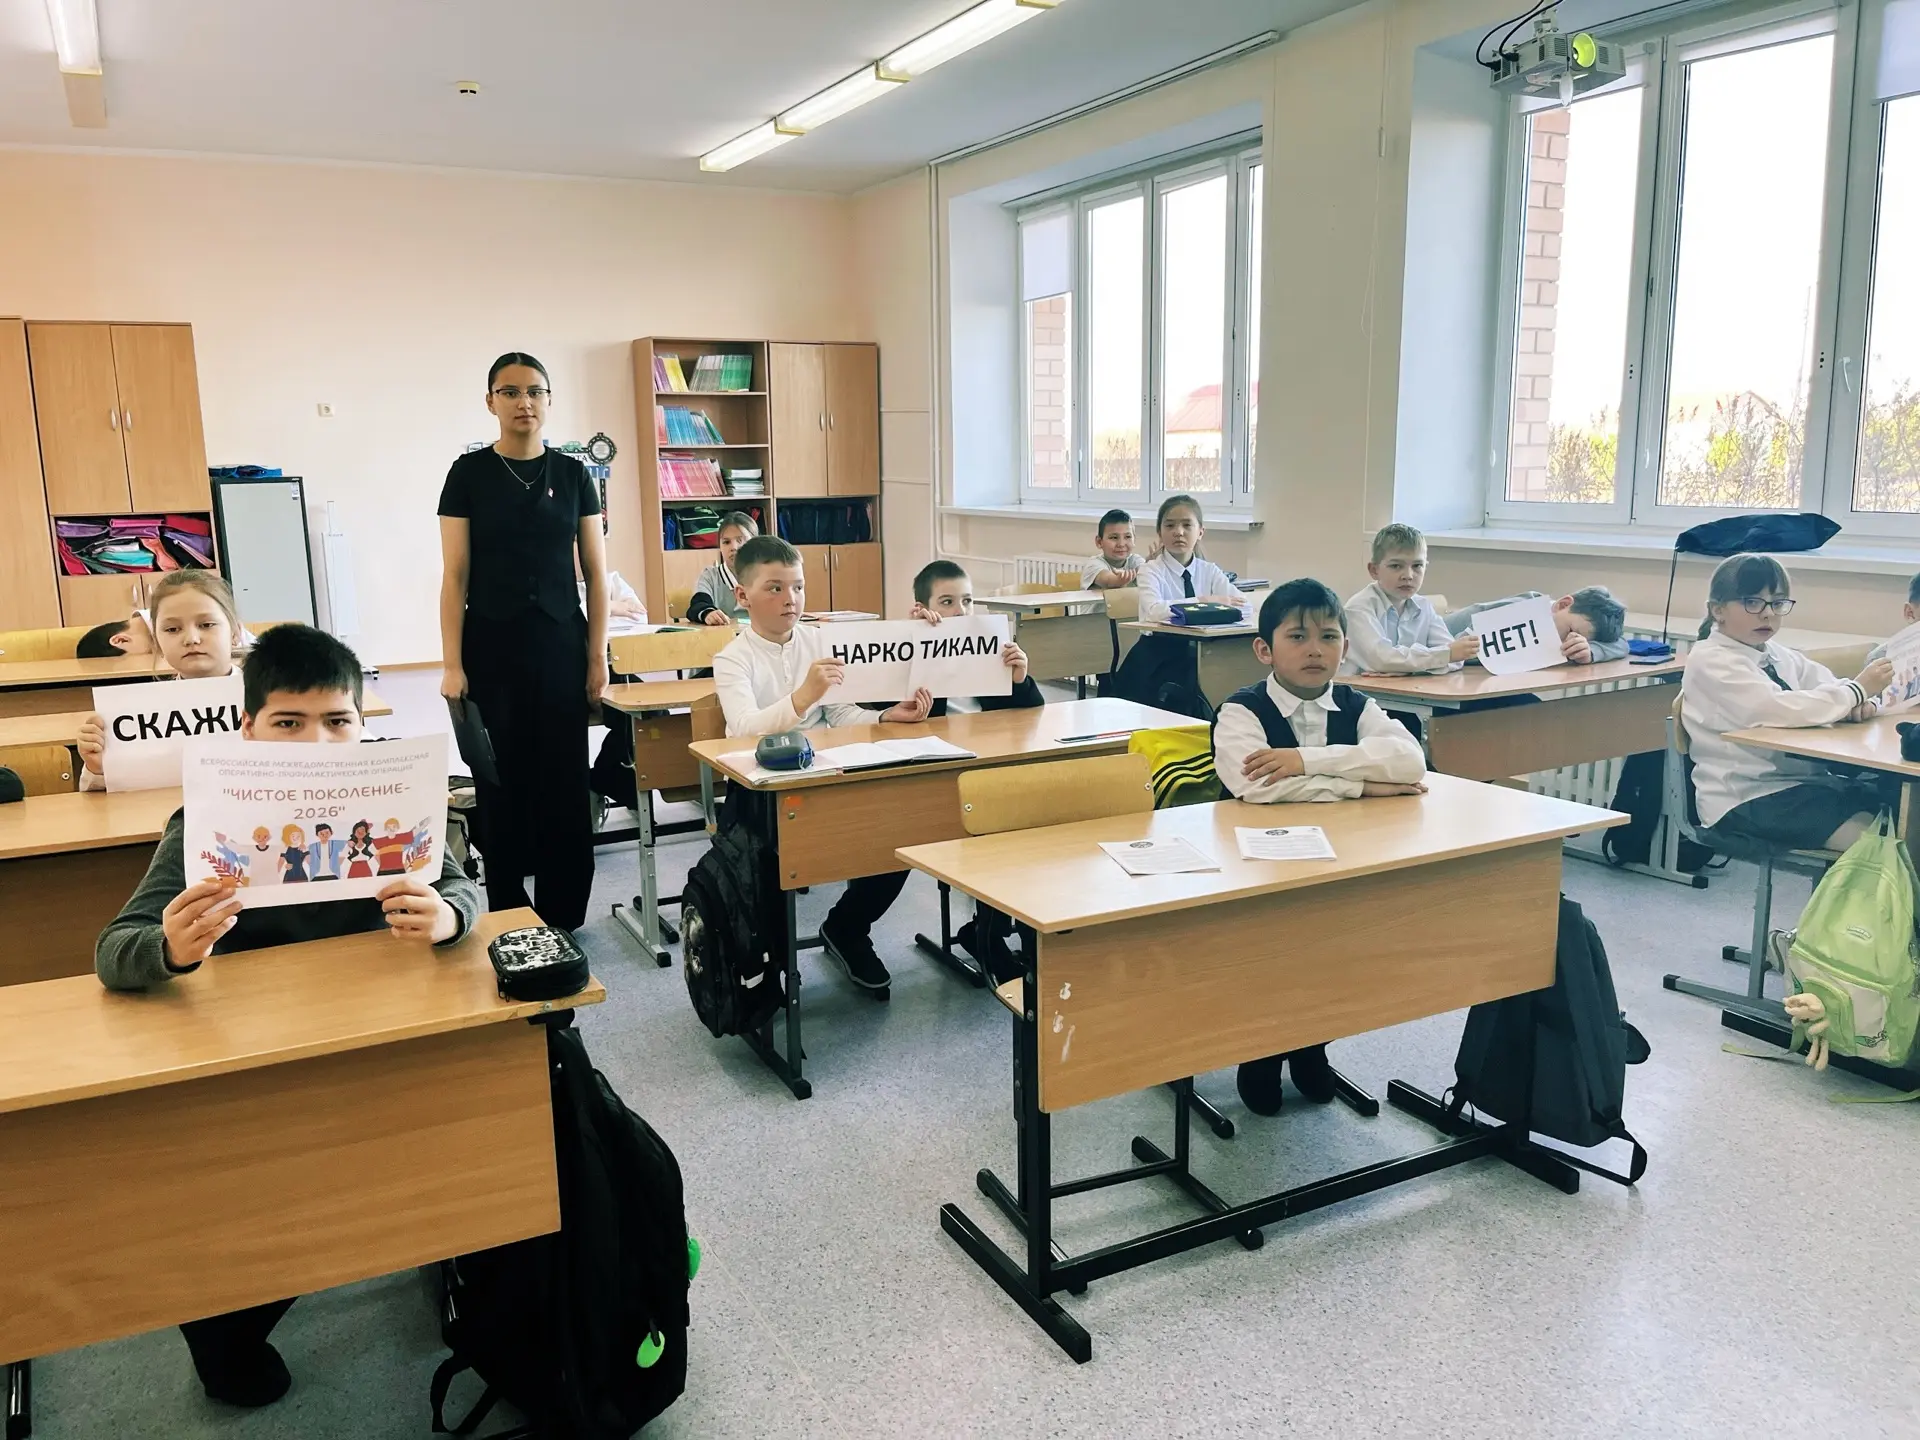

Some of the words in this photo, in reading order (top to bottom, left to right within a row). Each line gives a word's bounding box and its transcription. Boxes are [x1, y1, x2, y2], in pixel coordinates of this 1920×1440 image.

[832, 641, 914, 665] НАРКО
[920, 635, 998, 660] ТИКАМ
[1481, 619, 1539, 658] НЕТ!
[223, 788, 297, 801] "ЧИСТОЕ
[303, 782, 411, 801] ПОКОЛЕНИЕ-
[293, 805, 346, 820] 2026"
